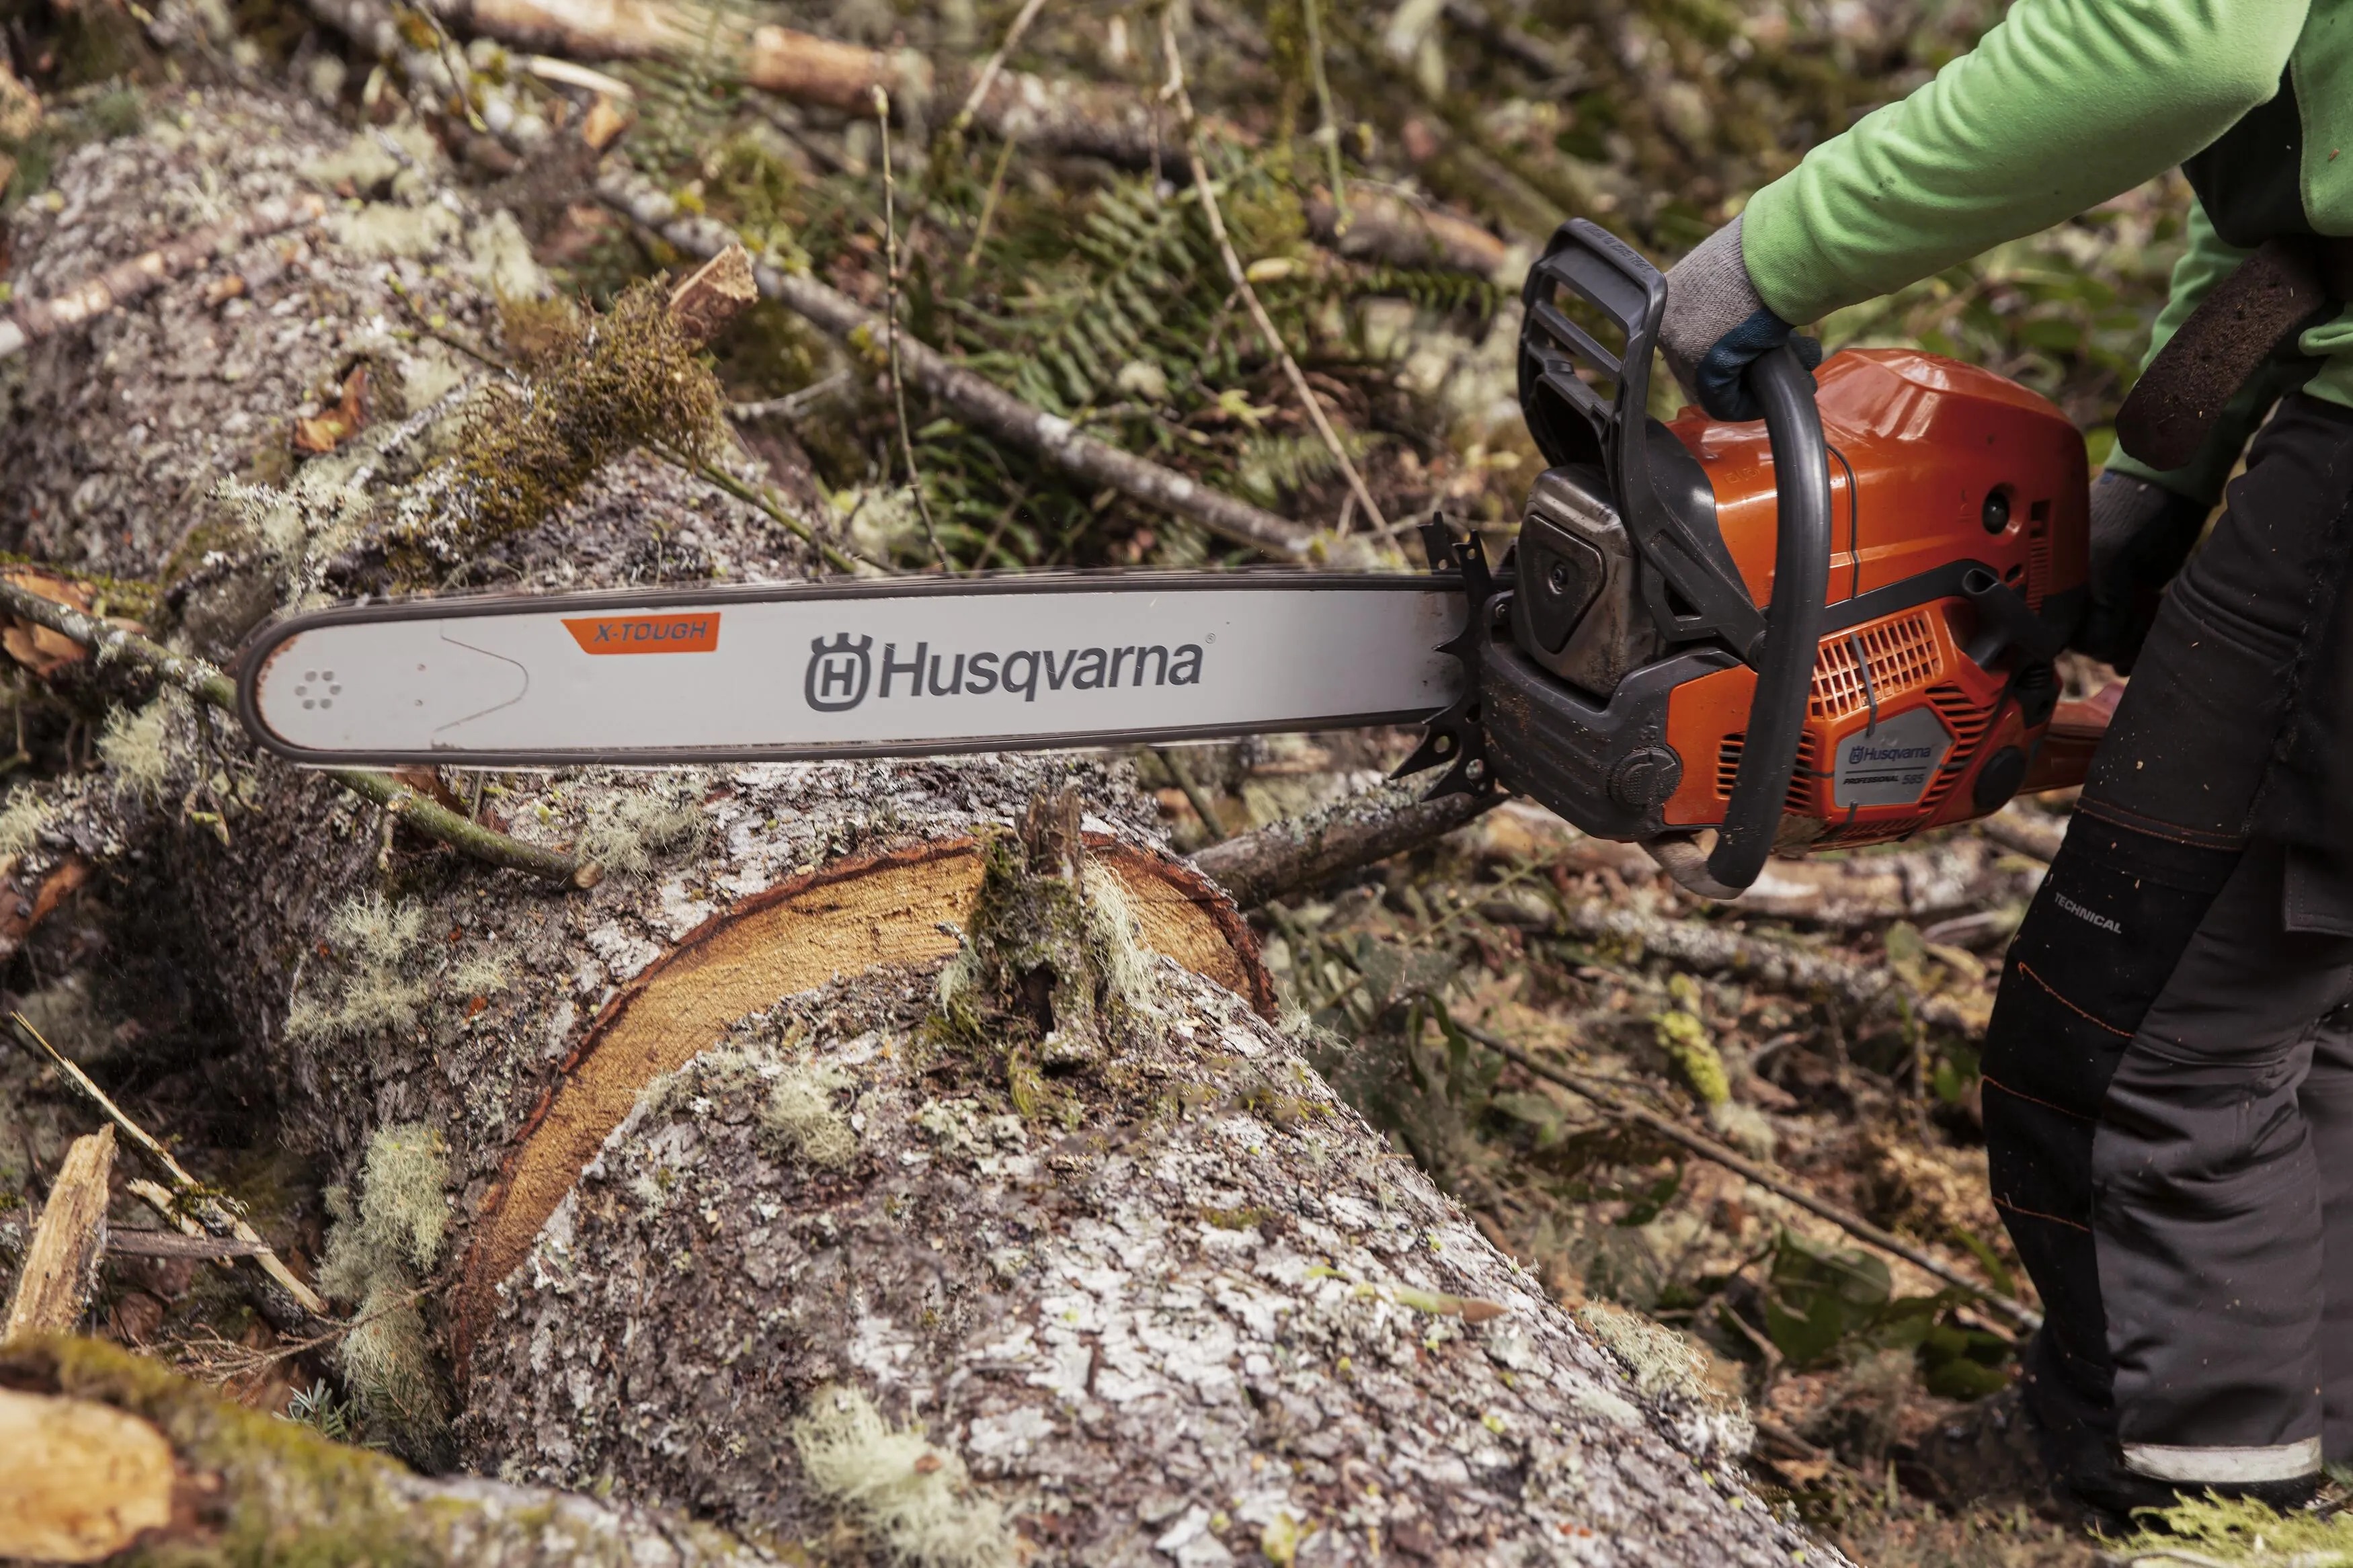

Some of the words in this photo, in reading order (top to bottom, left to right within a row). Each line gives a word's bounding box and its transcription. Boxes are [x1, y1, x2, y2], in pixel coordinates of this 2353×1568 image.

[595, 621, 707, 642] X-TOUGH
[878, 641, 1203, 702] Husqvarna
[1864, 747, 1931, 761] Husqvarna
[1843, 775, 1899, 785] PROFESSIONAL
[2055, 891, 2122, 934] TECHNICAL
